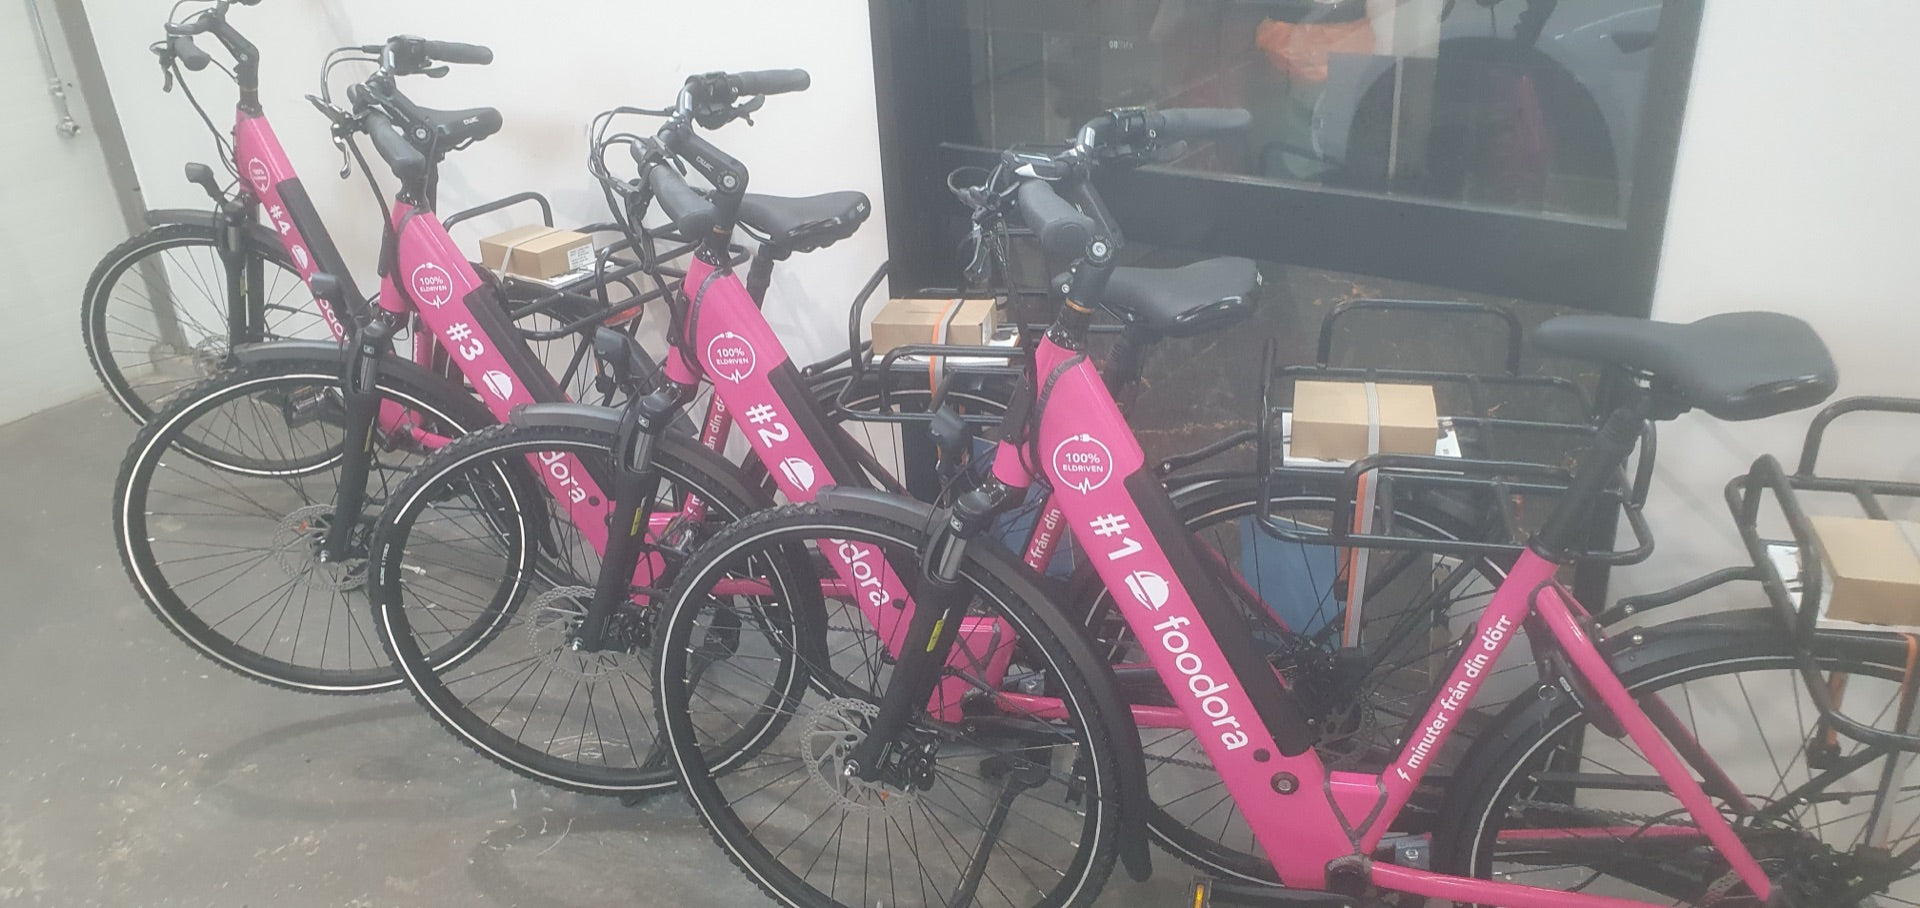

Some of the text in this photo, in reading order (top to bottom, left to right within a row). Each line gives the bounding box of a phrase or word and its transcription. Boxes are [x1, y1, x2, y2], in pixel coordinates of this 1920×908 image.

[270, 204, 291, 236] #4
[420, 276, 444, 285] 100%
[716, 358, 749, 366] ELDRIVEN
[717, 347, 745, 358] 100%
[446, 323, 586, 504] #3 dora
[710, 414, 723, 434] din
[1066, 453, 1100, 463] 100%
[745, 403, 890, 607] #2 dora
[1030, 532, 1051, 559] från
[1044, 508, 1061, 530] din
[1089, 513, 1249, 751] #1 foodora
[1407, 614, 1512, 769] minuter från din dörr
